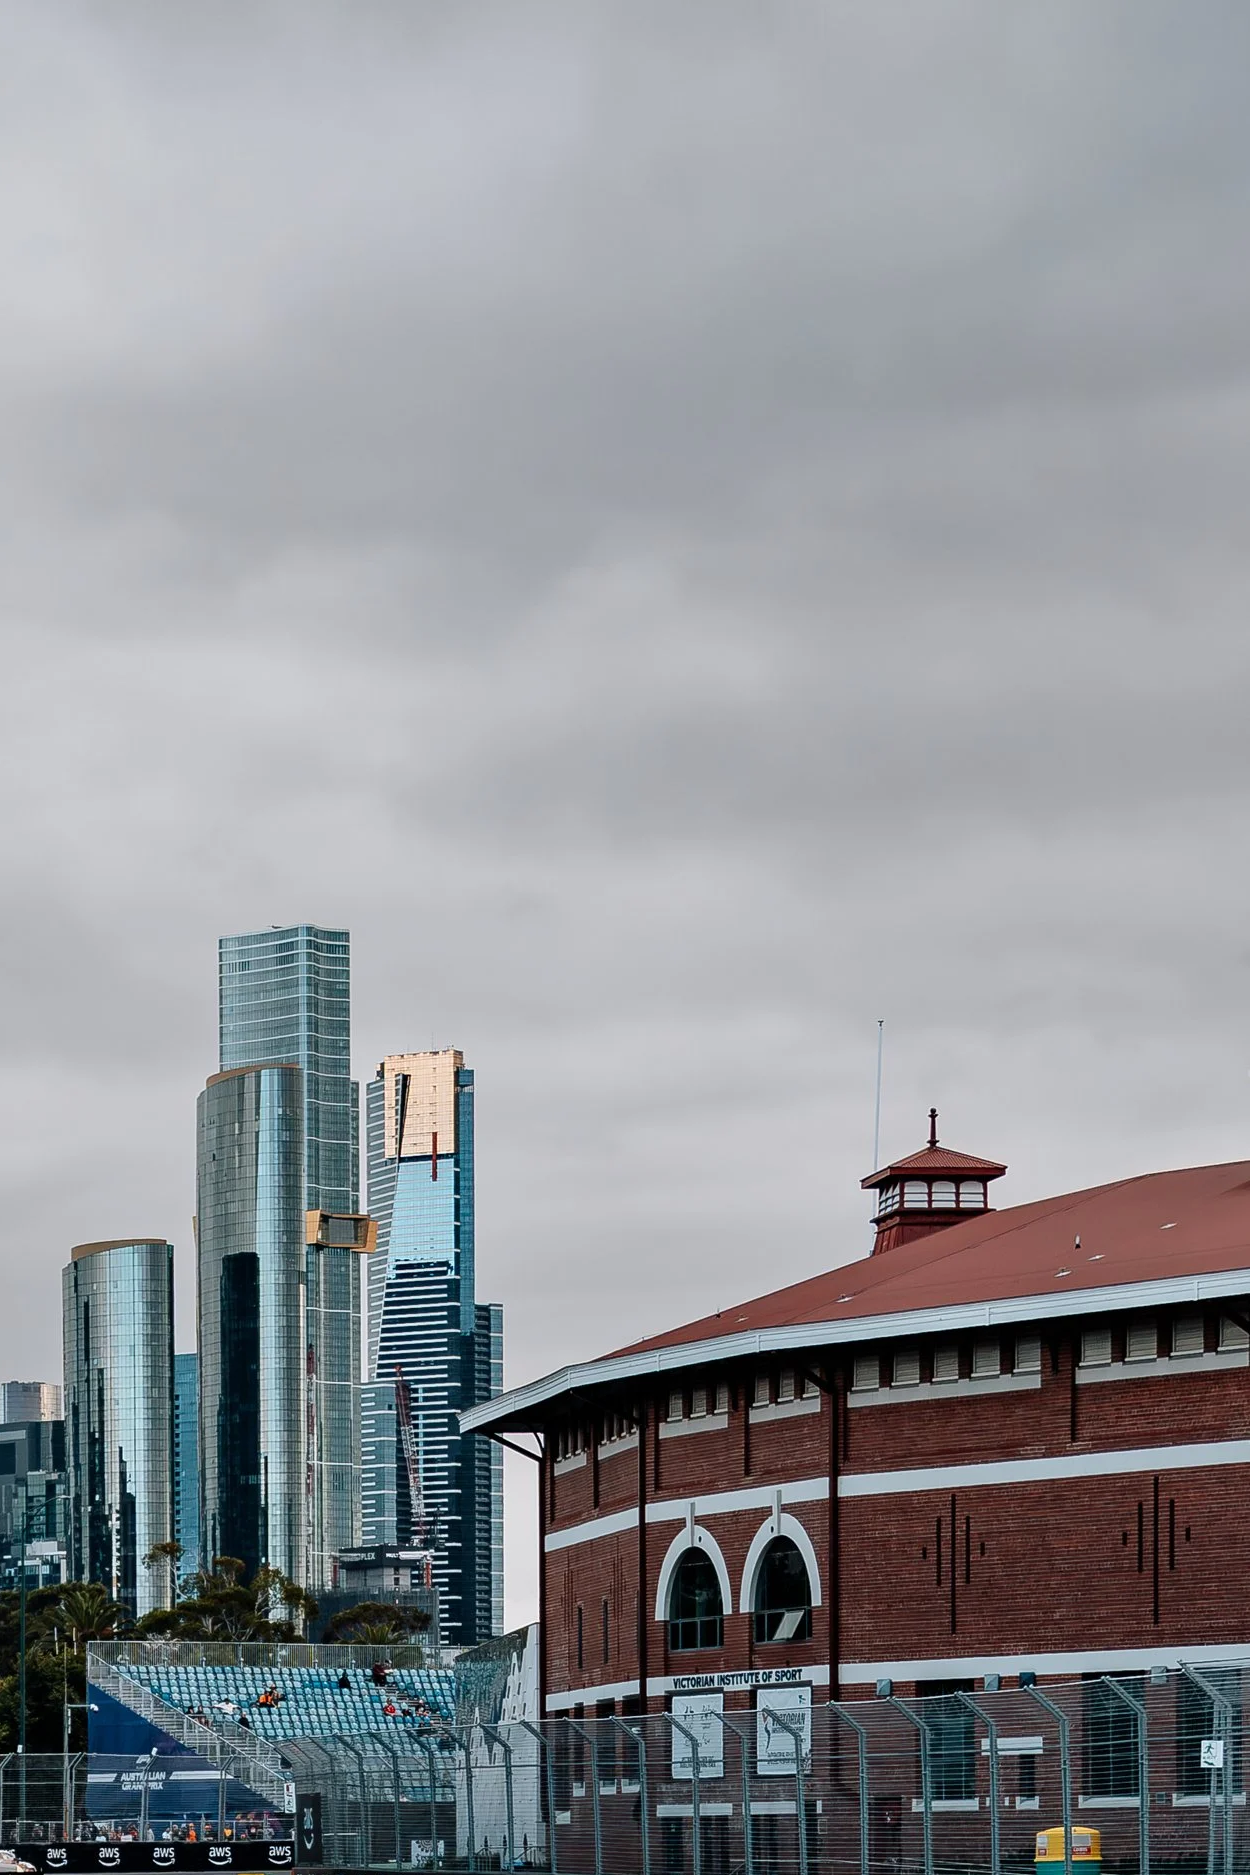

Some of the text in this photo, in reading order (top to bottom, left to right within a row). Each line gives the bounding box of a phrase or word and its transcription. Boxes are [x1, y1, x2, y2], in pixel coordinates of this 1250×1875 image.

[673, 1669, 803, 1689] VICTORIAN INSTITUTE OF SPORT
[47, 1848, 66, 1859] aws
[99, 1848, 120, 1858] aws
[153, 1847, 175, 1858] aws
[209, 1847, 231, 1857] aws
[269, 1846, 291, 1856] aws
